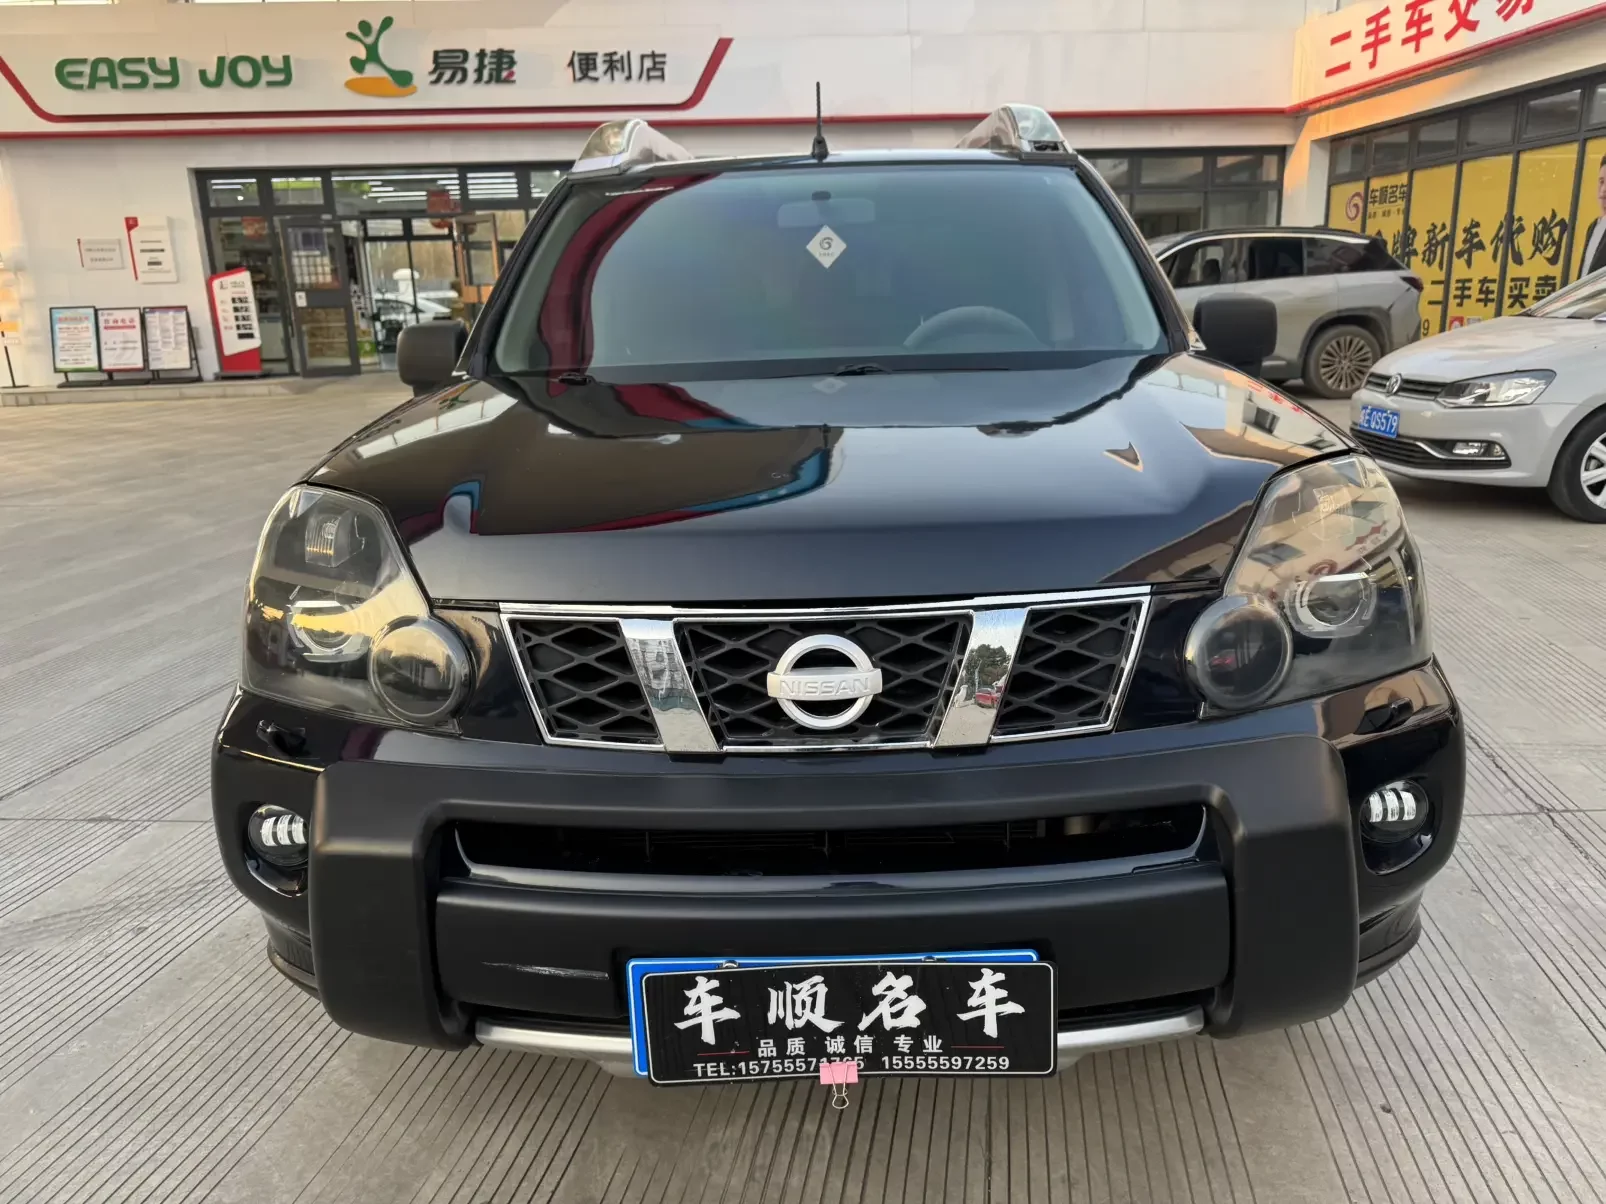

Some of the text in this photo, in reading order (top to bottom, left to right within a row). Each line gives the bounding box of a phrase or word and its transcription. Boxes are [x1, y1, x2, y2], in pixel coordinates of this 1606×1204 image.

[54, 55, 293, 91] EASY JOY
[428, 48, 667, 85] 易捷 便利店
[1374, 208, 1569, 272] 牌新车代购
[1427, 275, 1558, 309] 二手车买卖
[779, 677, 871, 696] NISSAN
[674, 967, 1025, 1046] 车顺名车
[757, 1034, 943, 1057] 品质 诚信 专业
[881, 1056, 1010, 1070] 15555597259
